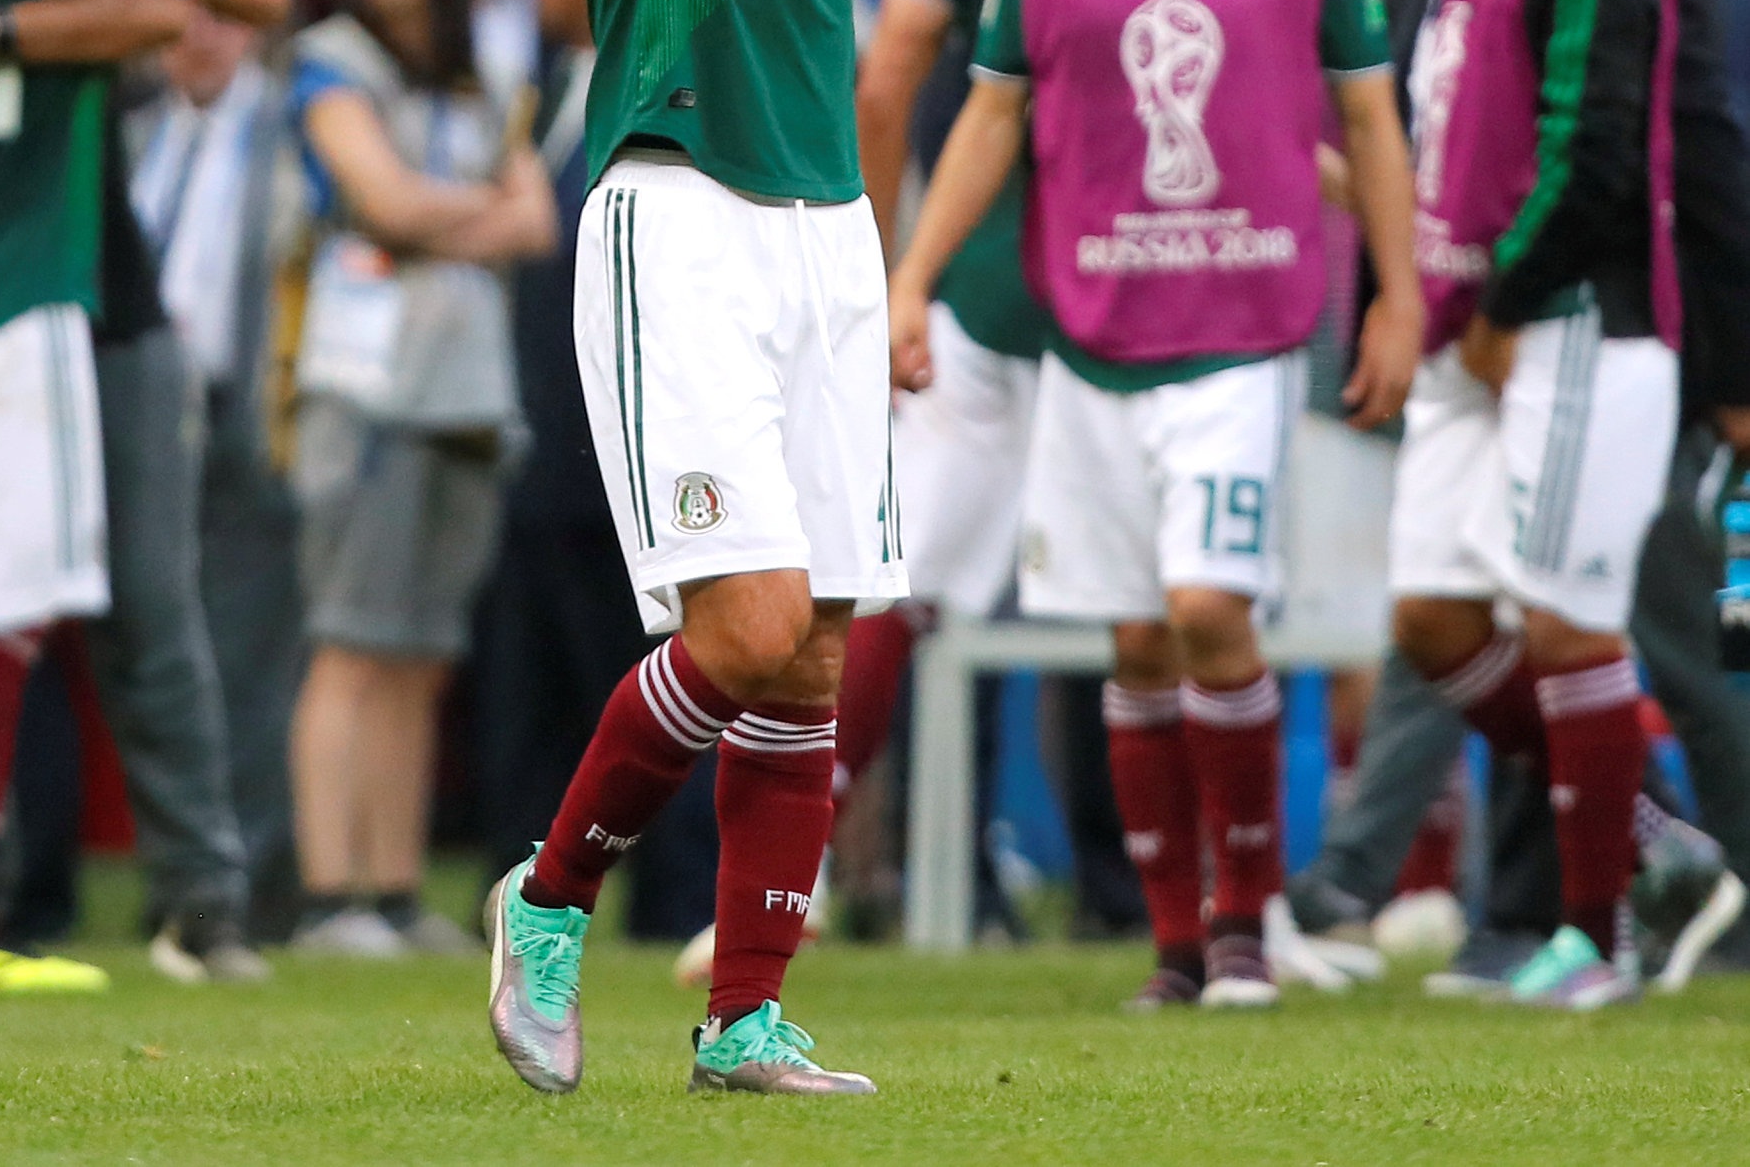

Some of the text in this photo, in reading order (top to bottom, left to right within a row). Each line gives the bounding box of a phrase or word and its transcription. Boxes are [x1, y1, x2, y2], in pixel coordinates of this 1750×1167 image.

[1076, 225, 1298, 273] RUSSIA 2018
[1194, 475, 1264, 555] 19
